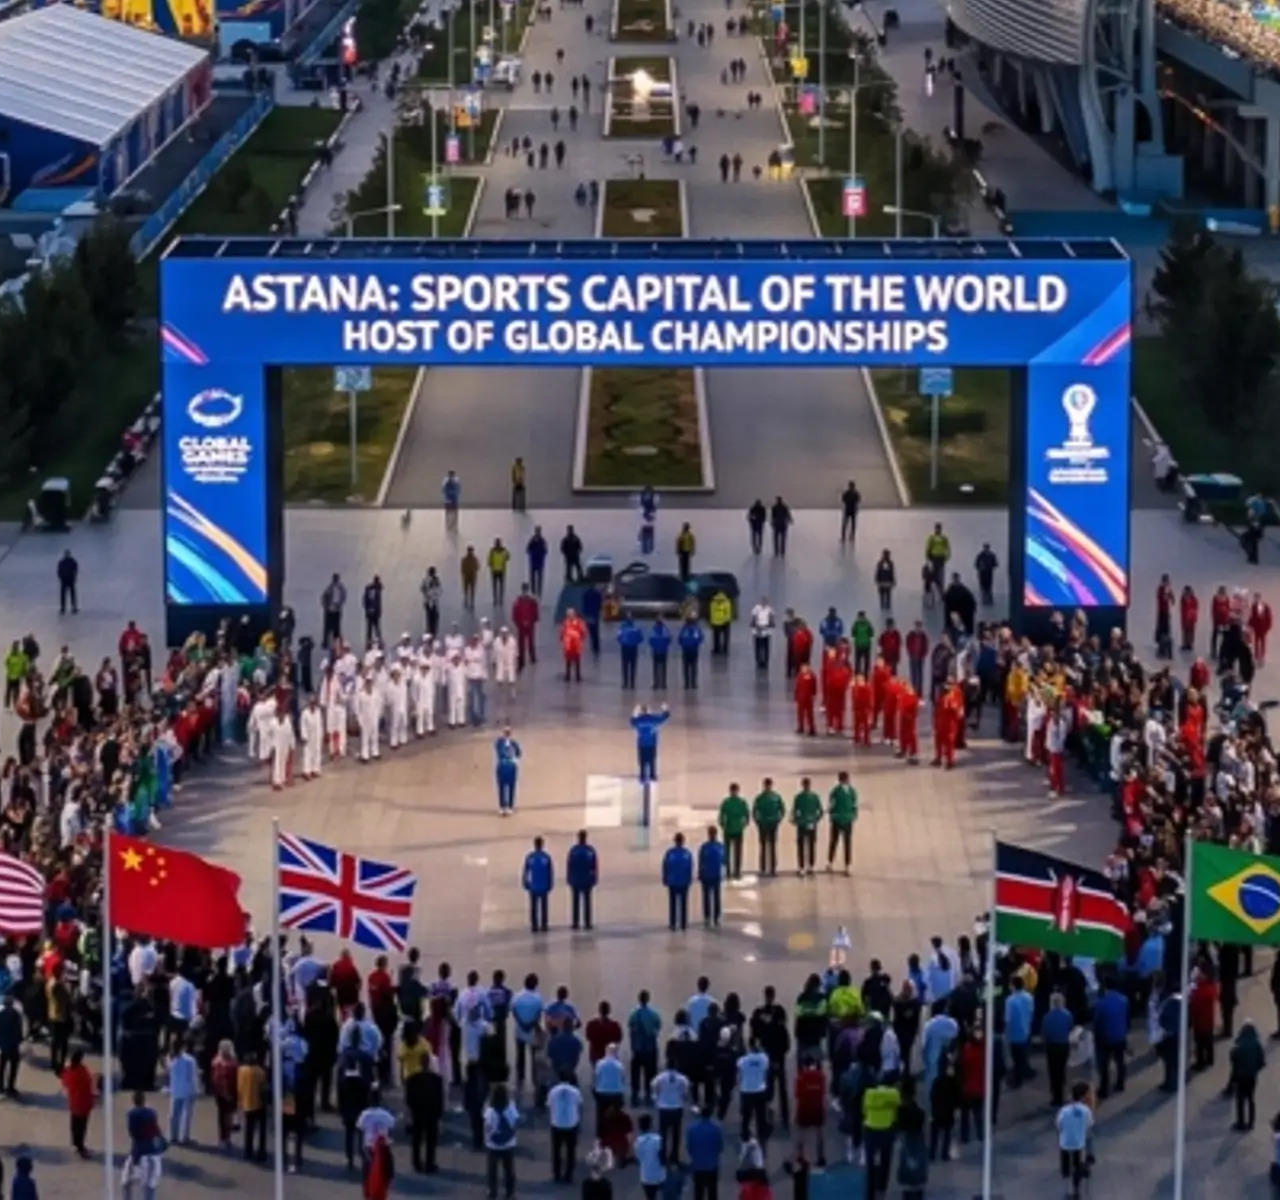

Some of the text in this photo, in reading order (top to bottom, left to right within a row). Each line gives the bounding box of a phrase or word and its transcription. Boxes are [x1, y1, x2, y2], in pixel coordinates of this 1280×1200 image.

[223, 273, 1068, 313] ASTANA: SPORTS CAPITAL OF THE WORLD
[343, 319, 949, 354] HOST OF GLOBAL CHAMPIONSHIPS
